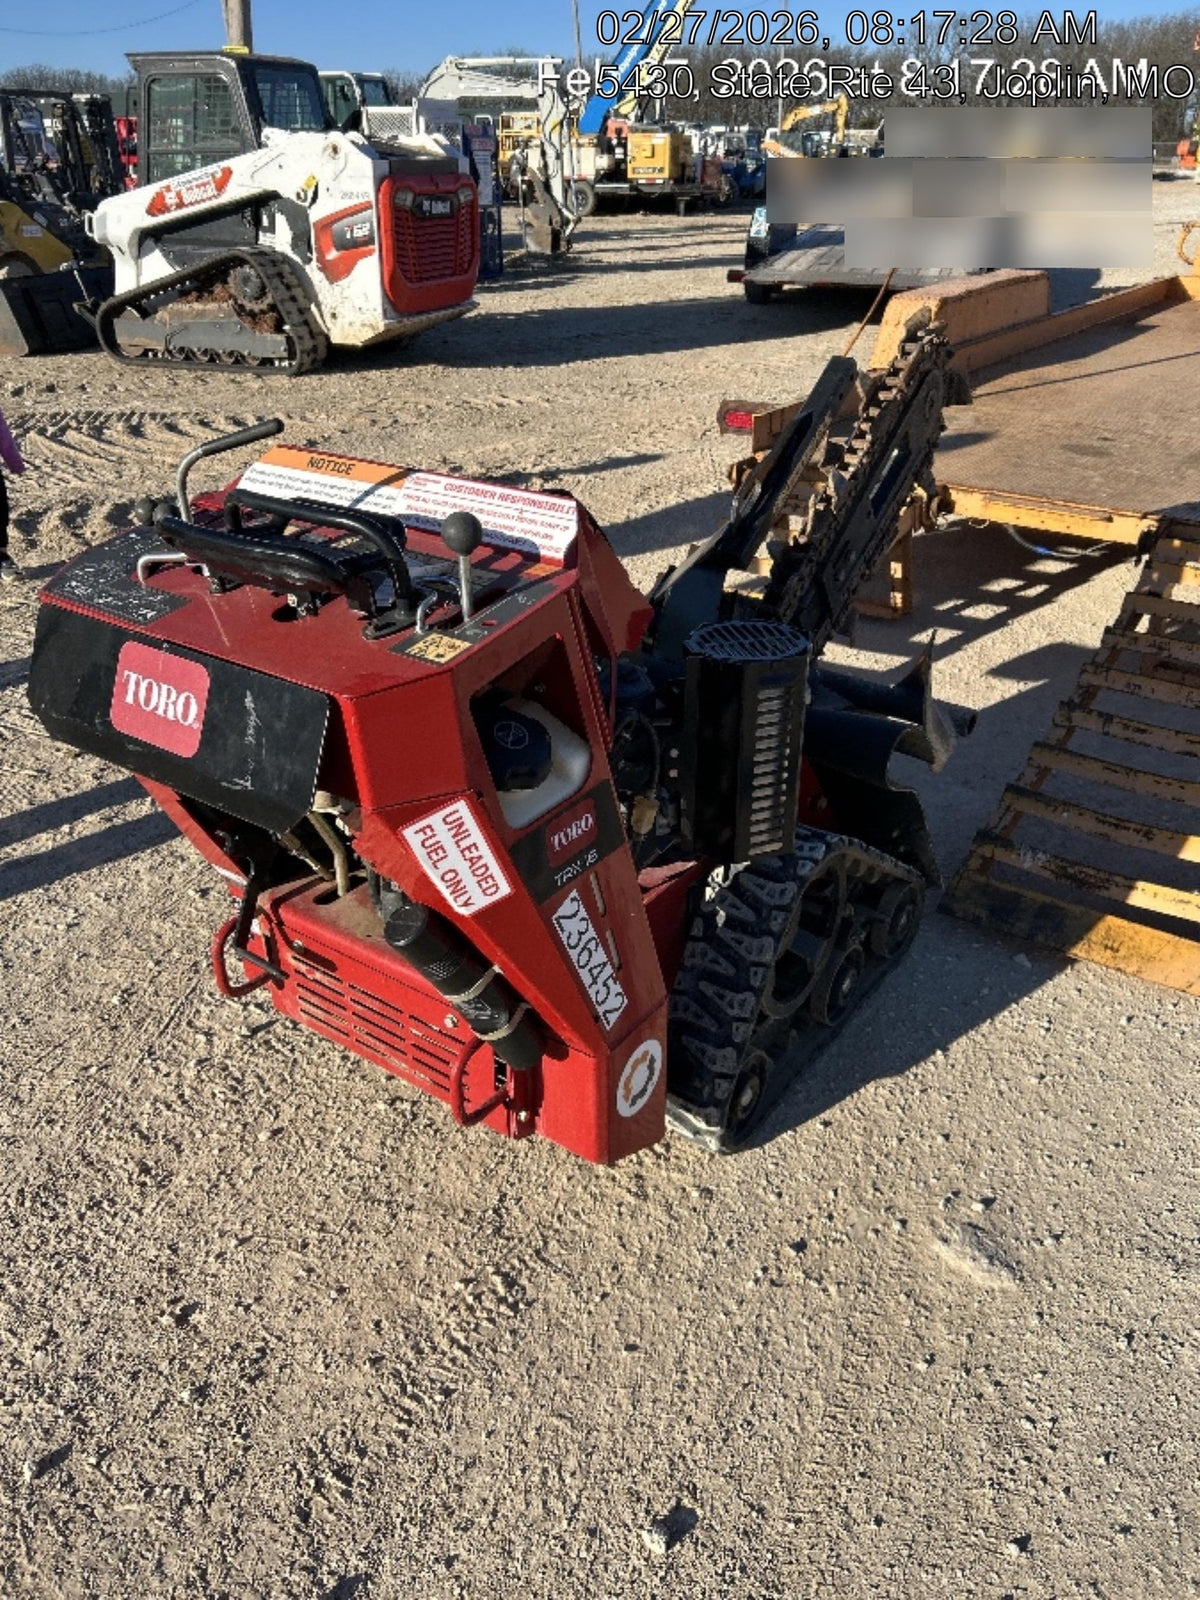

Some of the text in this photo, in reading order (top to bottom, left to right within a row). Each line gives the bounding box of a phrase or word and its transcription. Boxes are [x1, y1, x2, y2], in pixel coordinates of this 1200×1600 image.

[307, 456, 356, 475] NOTICE
[444, 482, 497, 500] CUSTOMER
[123, 670, 199, 727] TORO
[442, 809, 501, 898] UNLEADED
[550, 812, 595, 852] TORO
[414, 824, 475, 909] FUEL ONLY
[555, 896, 628, 1028] 236452
